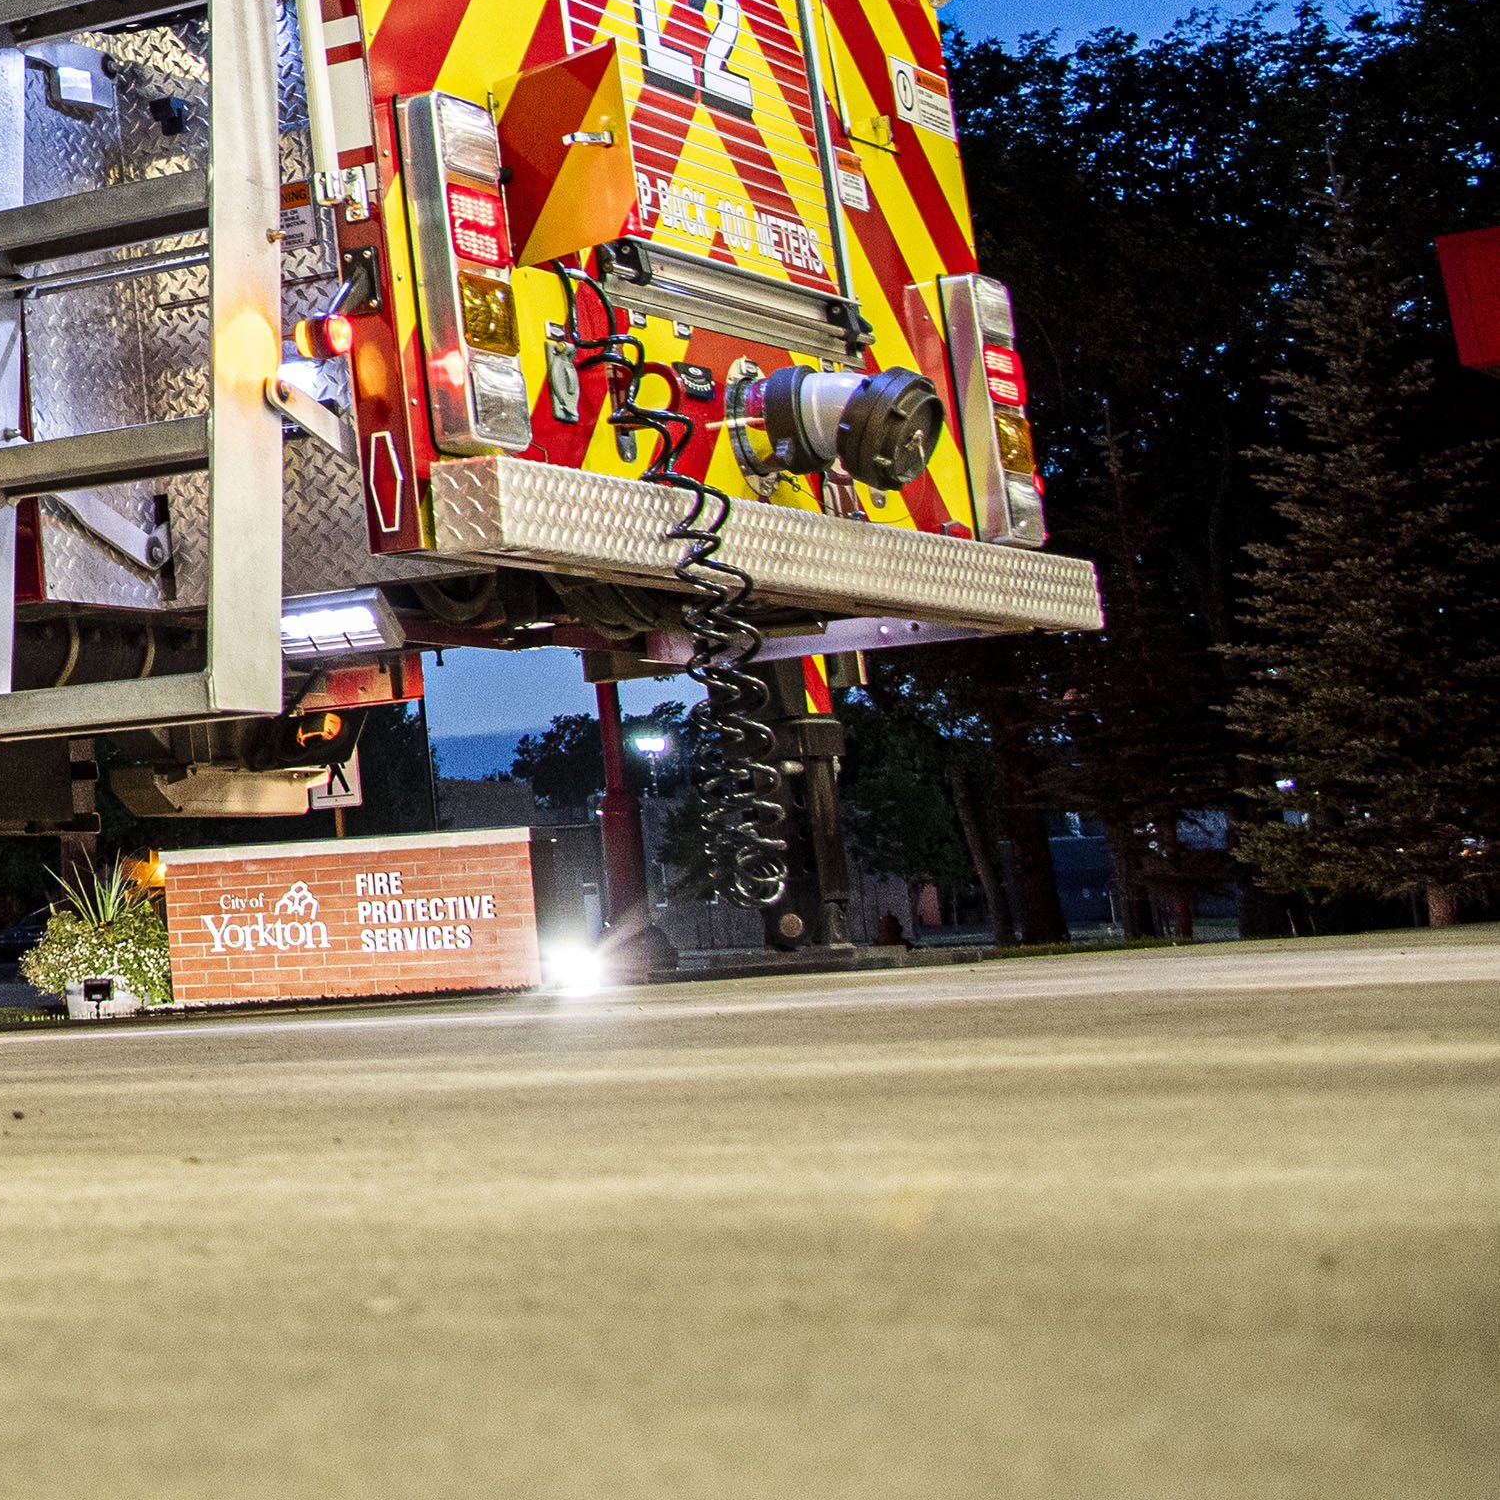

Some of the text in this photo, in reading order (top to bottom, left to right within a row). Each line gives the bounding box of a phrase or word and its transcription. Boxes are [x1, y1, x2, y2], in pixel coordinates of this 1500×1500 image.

[281, 188, 307, 204] NING
[655, 177, 712, 241] BACK
[717, 196, 752, 252] 100
[753, 209, 825, 275] METERS
[355, 871, 405, 897] FIRE
[218, 892, 265, 911] City of
[357, 895, 498, 925] PROTECTIVE
[200, 912, 332, 953] Yorkton
[360, 924, 474, 953] SERVICES
